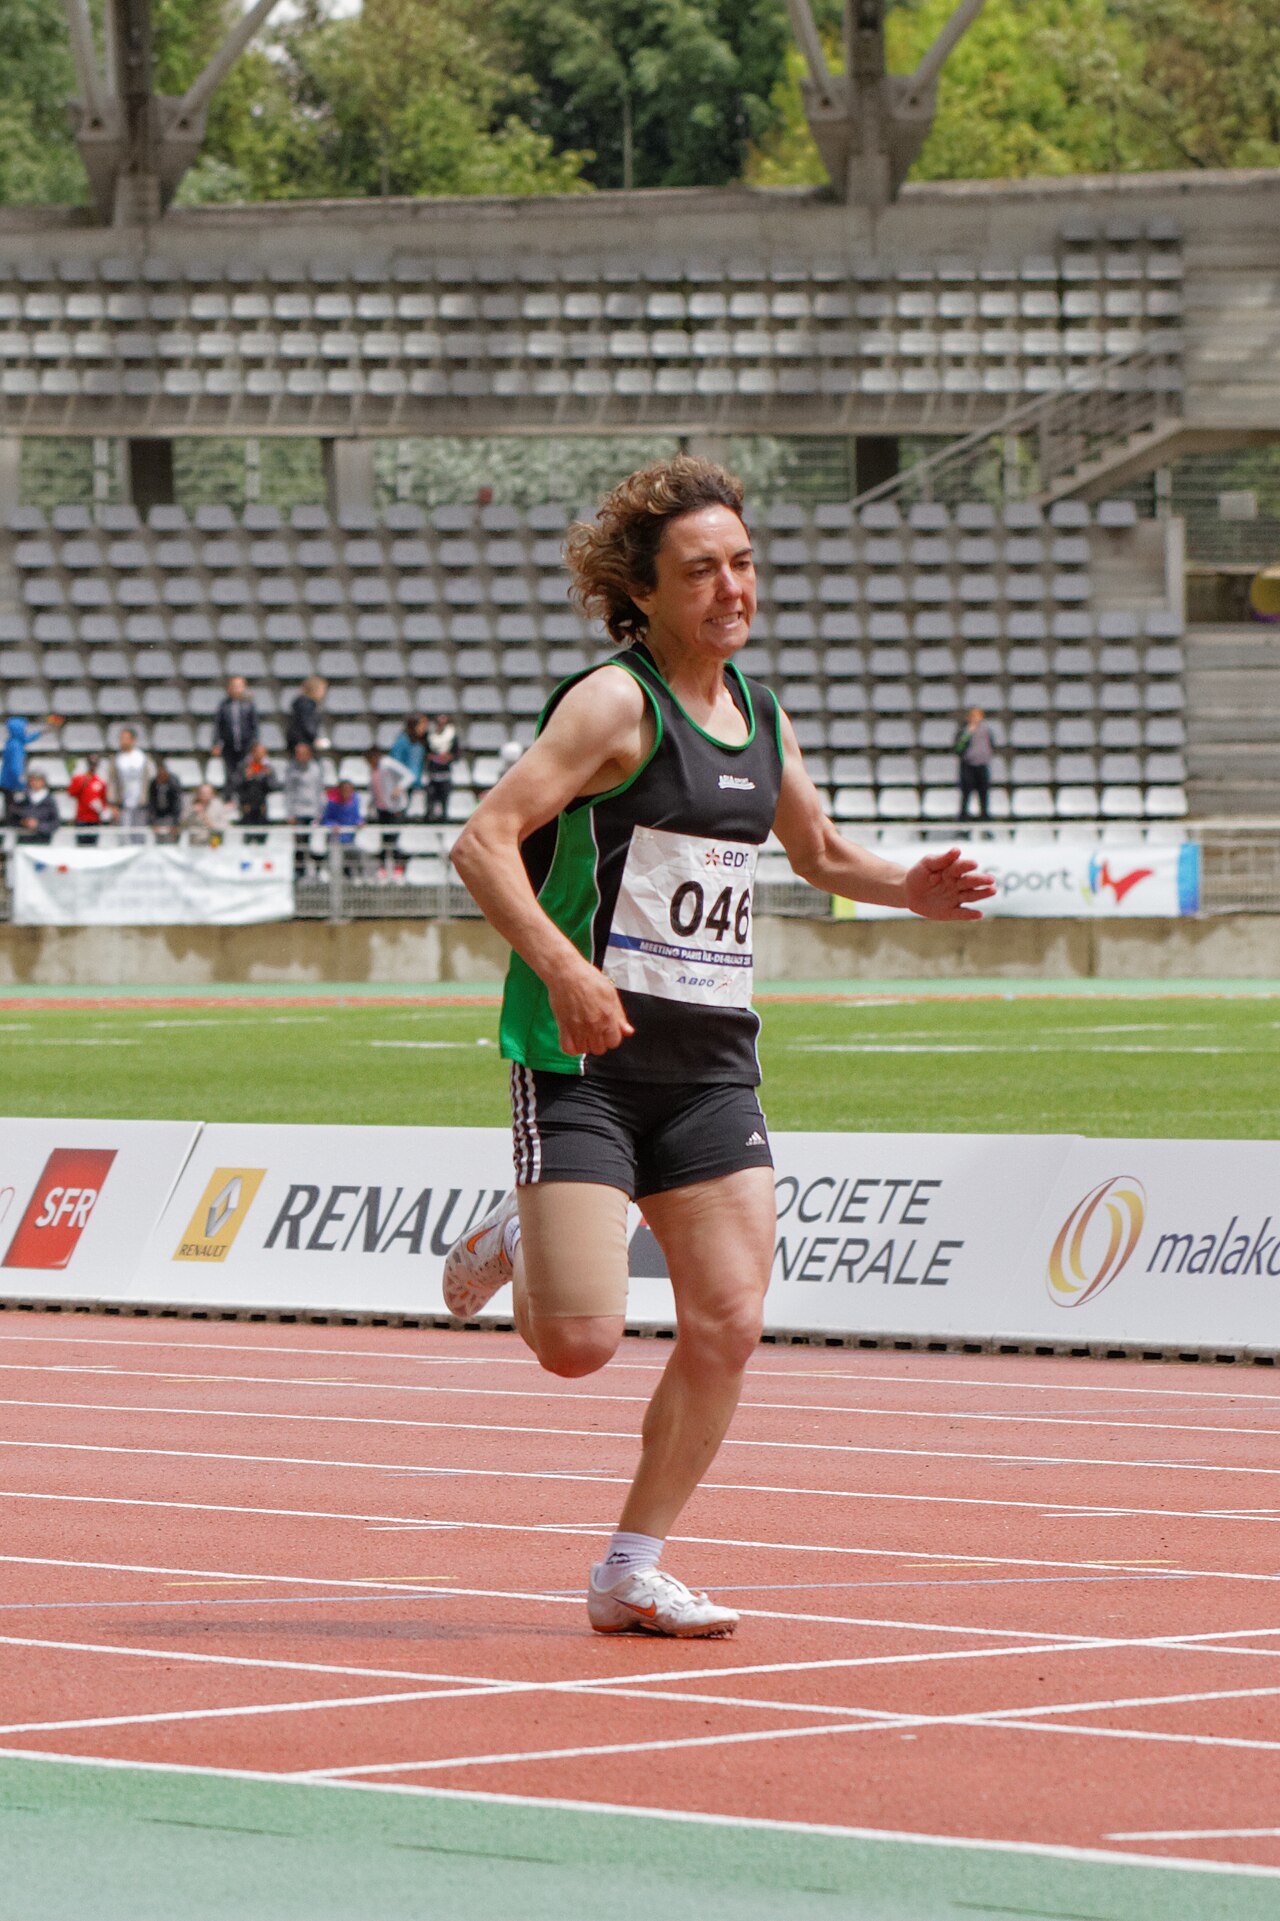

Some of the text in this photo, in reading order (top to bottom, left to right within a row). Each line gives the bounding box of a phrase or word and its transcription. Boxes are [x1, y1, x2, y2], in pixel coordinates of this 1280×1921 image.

[670, 881, 750, 945] 046
[639, 941, 680, 957] MEETING
[681, 949, 702, 961] PARIS
[35, 1187, 97, 1228] SFR
[774, 1176, 943, 1225] OCIETE
[179, 1244, 227, 1257] RENAULT
[773, 1236, 965, 1286] NERALE
